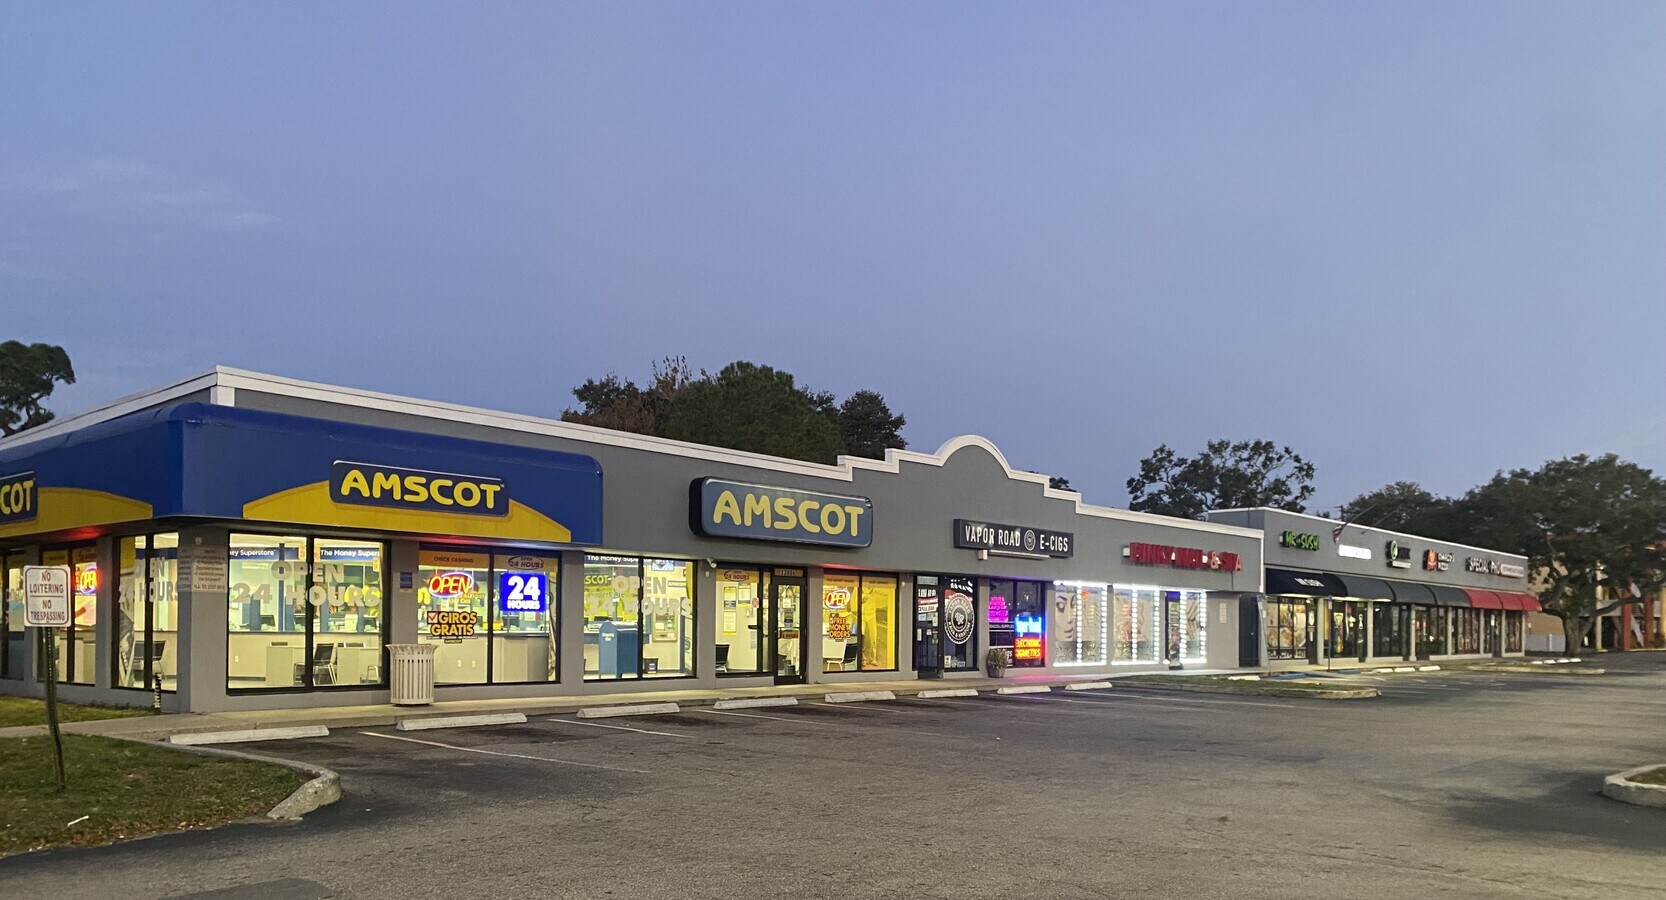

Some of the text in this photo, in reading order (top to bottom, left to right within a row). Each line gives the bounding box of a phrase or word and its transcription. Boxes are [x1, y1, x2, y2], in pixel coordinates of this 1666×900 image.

[340, 469, 501, 509] AMSCOT
[0, 480, 34, 514] COT
[713, 490, 865, 537] AMSCOT
[965, 525, 1068, 552] VAPOR ROAD E-CIGS
[240, 549, 275, 557] Superstore
[334, 549, 357, 557] Money
[520, 561, 545, 569] HOURS
[41, 571, 51, 582] NO
[271, 560, 345, 583] OPEN
[430, 575, 470, 594] OPEN
[585, 575, 609, 584] SCOT
[613, 575, 667, 594] OPEN
[30, 584, 64, 594] LOITERING
[507, 575, 541, 600] 24
[232, 583, 381, 607] 24 HOURS
[827, 592, 848, 605] OPEN
[43, 600, 52, 609] NO
[507, 600, 541, 610] HOURS
[624, 597, 693, 617] HOURS
[31, 611, 65, 621] TRESPASSING
[438, 612, 477, 624] GIROS
[431, 624, 474, 636] GRATIS
